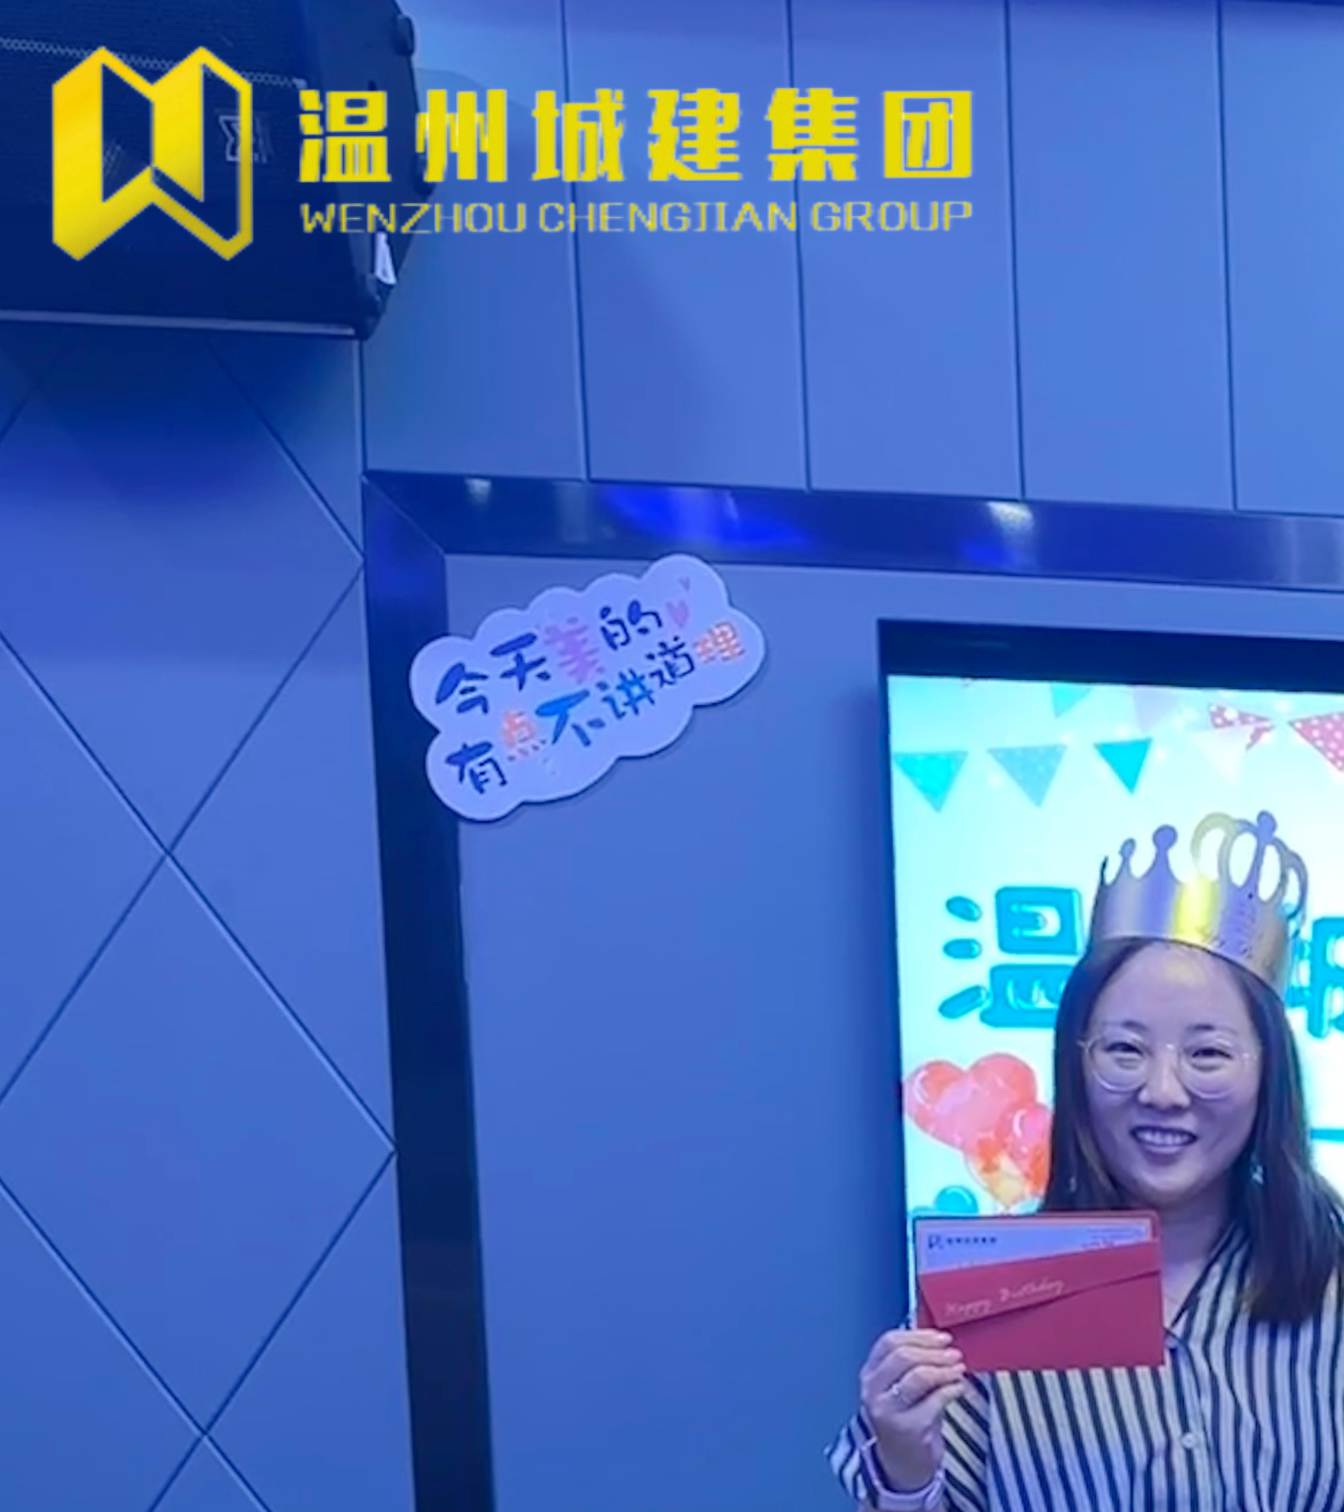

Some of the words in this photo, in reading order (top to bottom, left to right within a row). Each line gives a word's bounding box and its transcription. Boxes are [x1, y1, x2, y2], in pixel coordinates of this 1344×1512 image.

[435, 599, 663, 714] 今天美的
[445, 621, 745, 794] 有点不讲道理
